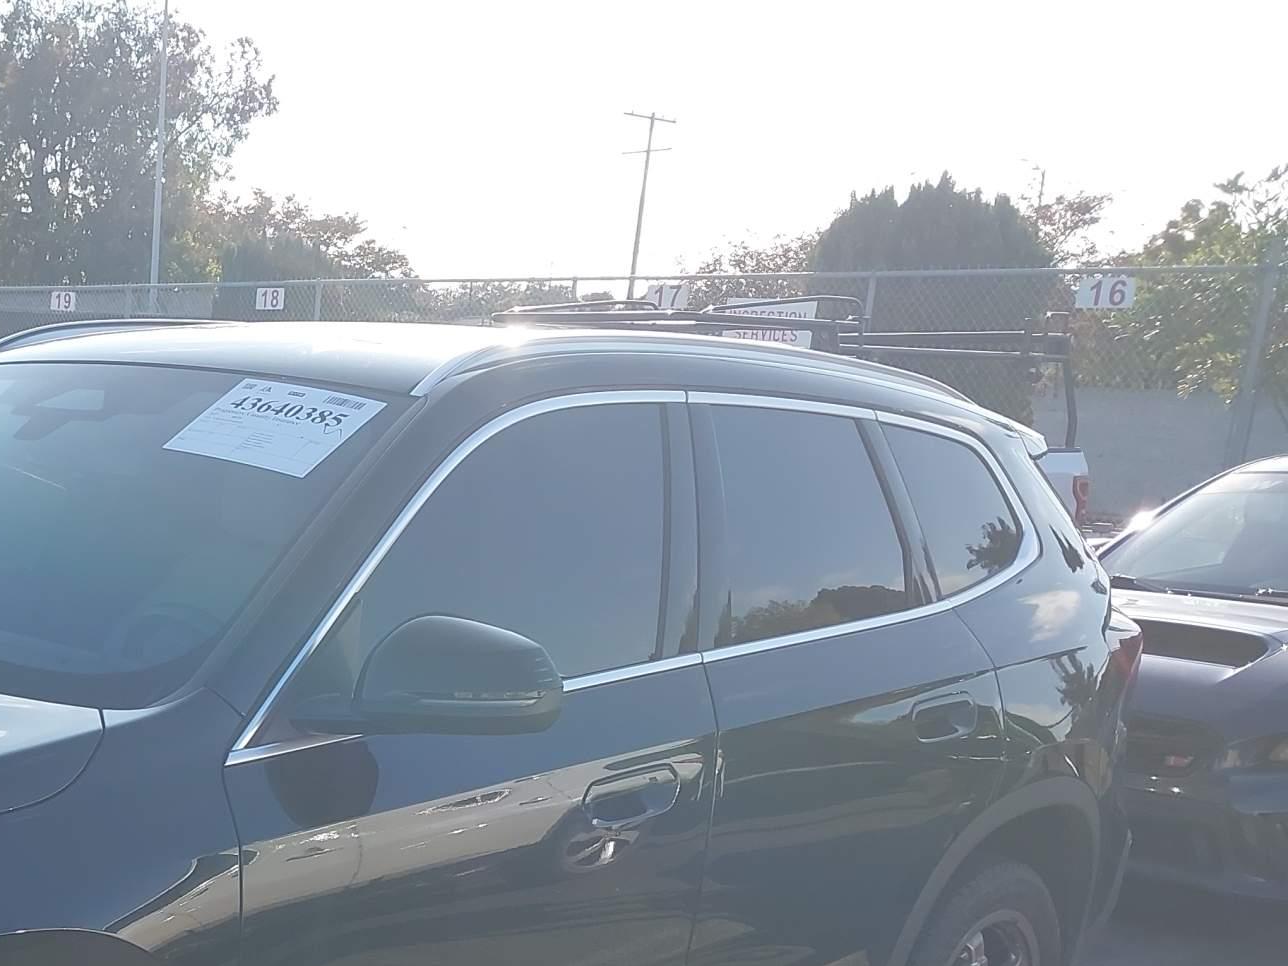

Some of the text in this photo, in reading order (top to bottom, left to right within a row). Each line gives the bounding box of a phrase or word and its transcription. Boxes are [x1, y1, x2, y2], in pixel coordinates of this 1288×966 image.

[55, 292, 72, 309] 19
[262, 289, 279, 308] 18
[654, 285, 682, 307] 17
[1090, 280, 1127, 306] 16
[230, 396, 350, 427] 43640385
